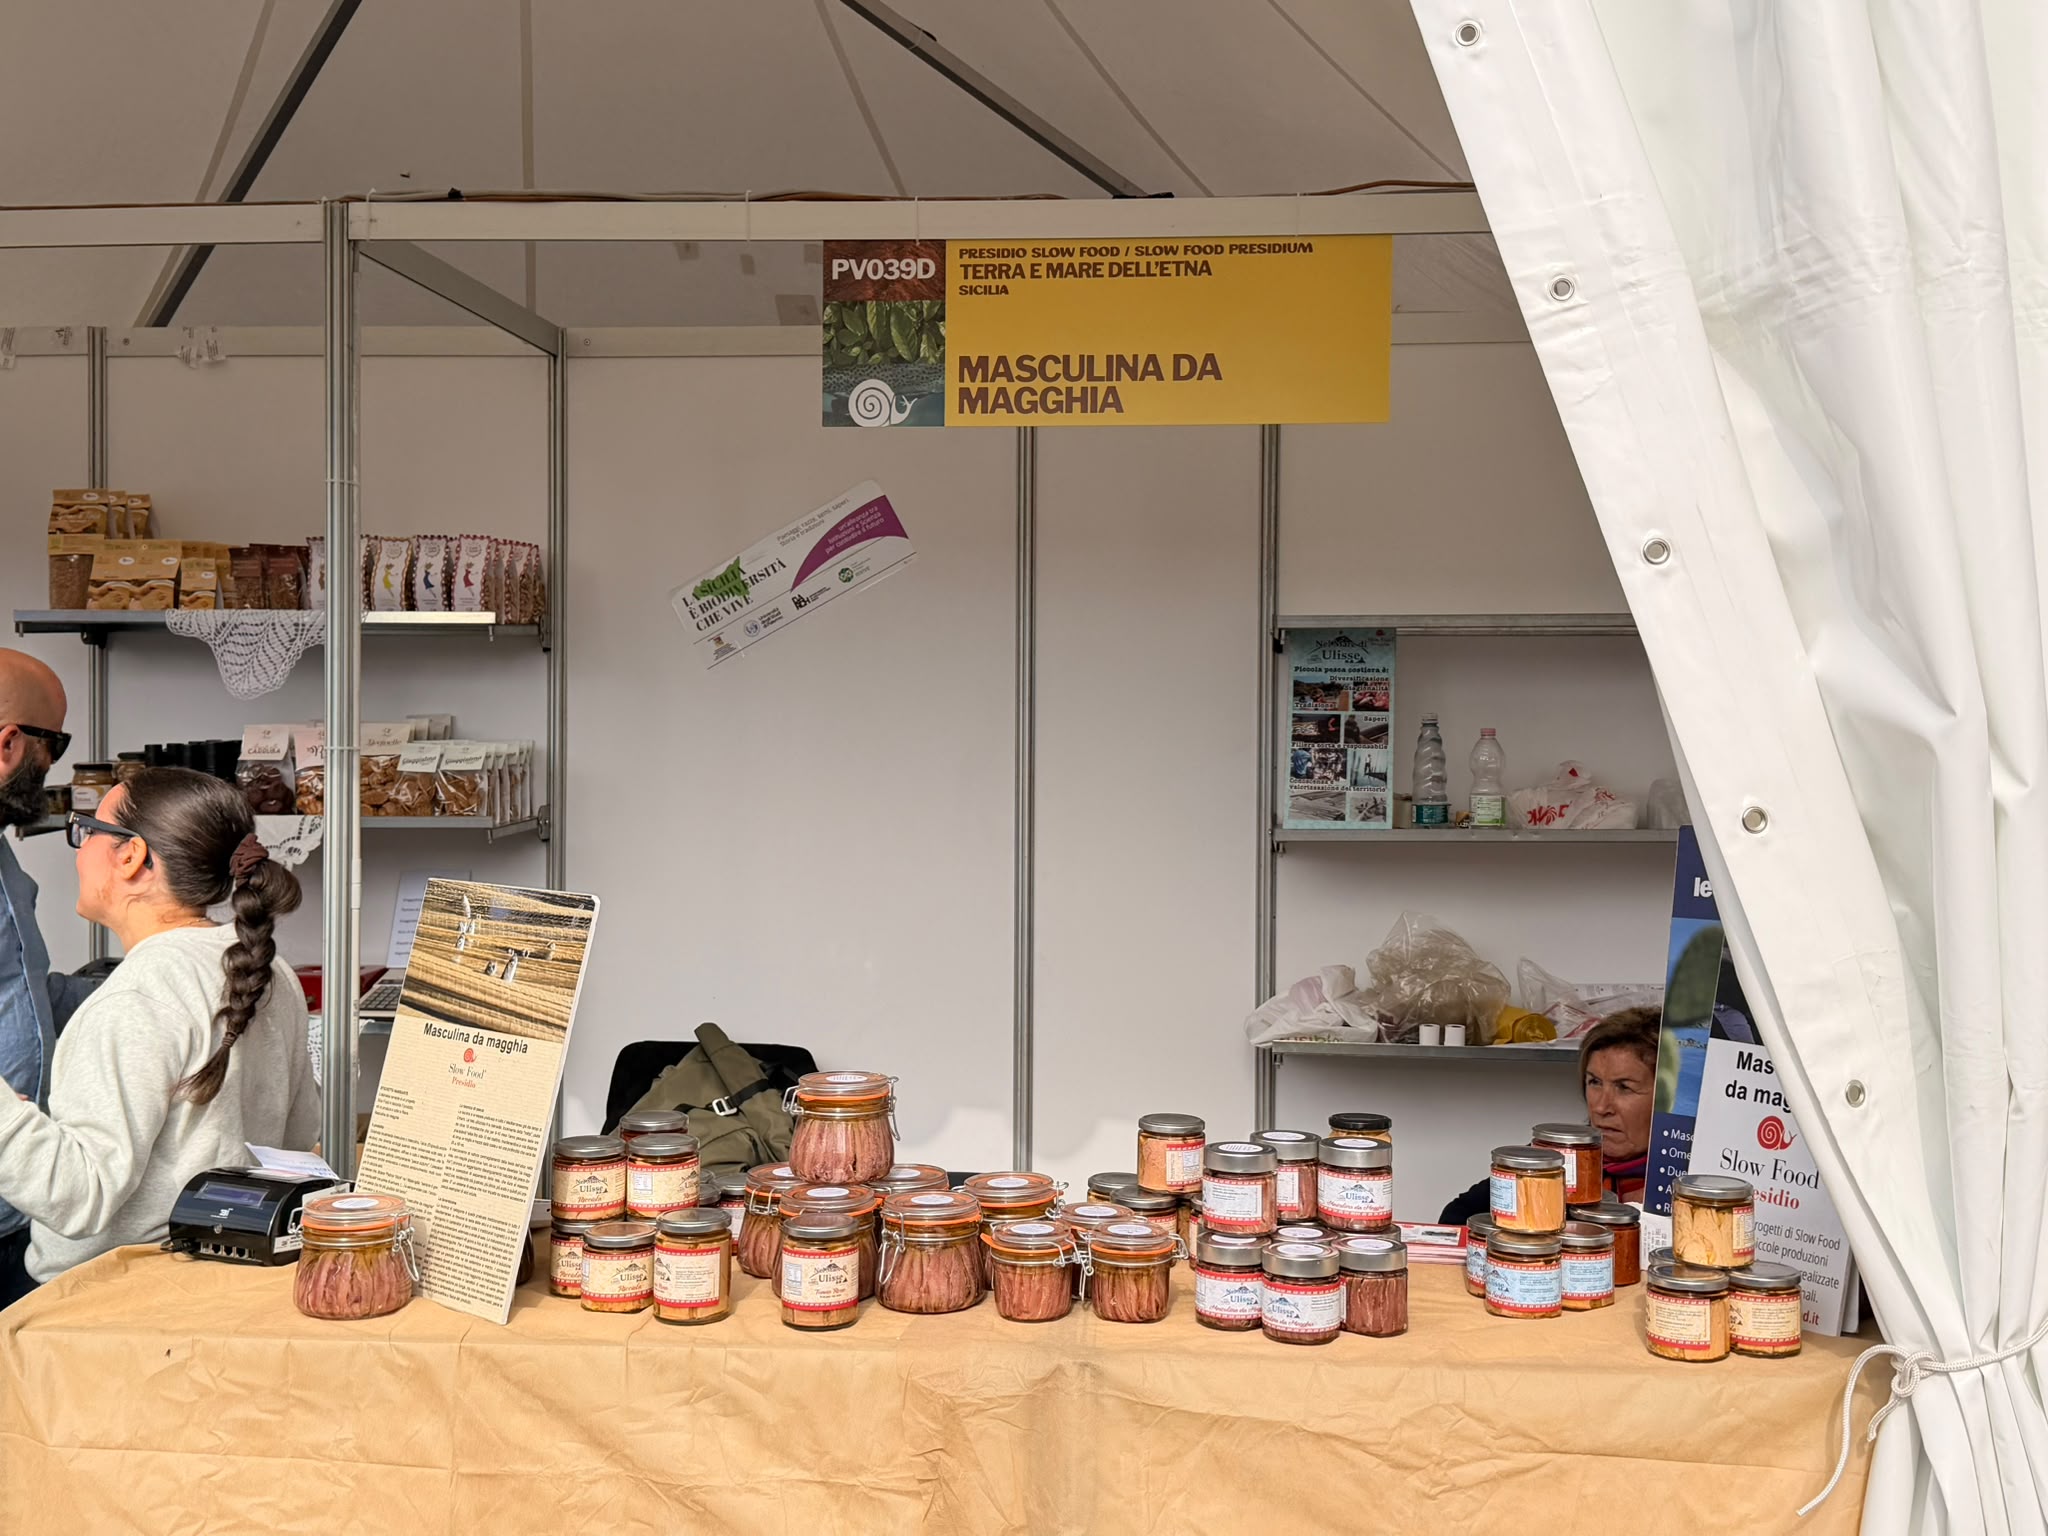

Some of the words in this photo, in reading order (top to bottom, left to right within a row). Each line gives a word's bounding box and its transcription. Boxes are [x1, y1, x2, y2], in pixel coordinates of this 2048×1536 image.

[959, 247, 1027, 260] PRESIDIO
[1031, 246, 1076, 259] SLOW
[1079, 246, 1121, 258] FOOD
[1124, 245, 1130, 258] /
[1134, 244, 1180, 258] SLOW
[1183, 244, 1225, 256] FOOD
[1228, 242, 1314, 256] PRESIDIUM
[832, 258, 936, 280] PV039D
[960, 263, 1025, 281] TERRA
[1030, 263, 1042, 280] E
[1046, 262, 1105, 279] MARE
[1108, 260, 1212, 278] DELL'ETNA
[958, 284, 1009, 296] SICILIA
[958, 354, 1164, 383] MASCULINA
[1172, 353, 1223, 381] DA
[958, 386, 1124, 415] MAGGHIA
[859, 511, 881, 525] Scienza
[825, 546, 835, 554] per
[865, 518, 884, 530] futuro
[698, 558, 787, 614] BIODIVERSITÀ
[700, 566, 746, 596] SICILIA
[696, 612, 724, 632] CHE
[722, 595, 754, 616] VIVE
[1322, 650, 1360, 660] Ulisse
[424, 1022, 470, 1043] Masculina
[472, 1032, 484, 1046] da
[486, 1036, 528, 1054] magghia
[448, 1064, 464, 1075] Slow
[1736, 1050, 1774, 1074] Mas
[452, 1076, 476, 1088] Presidio
[1725, 1080, 1748, 1100] da
[1720, 1148, 1766, 1176] Slow
[1771, 1158, 1820, 1190] Food
[580, 1185, 604, 1193] Ulisse
[1346, 1192, 1369, 1201] Ulisse
[1784, 1226, 1794, 1239] di
[1795, 1228, 1816, 1244] Slow
[1818, 1234, 1840, 1250] Food
[1781, 1246, 1829, 1268] produzioni
[818, 1274, 843, 1283] Ulisse
[1272, 1304, 1294, 1315] Ulisse
